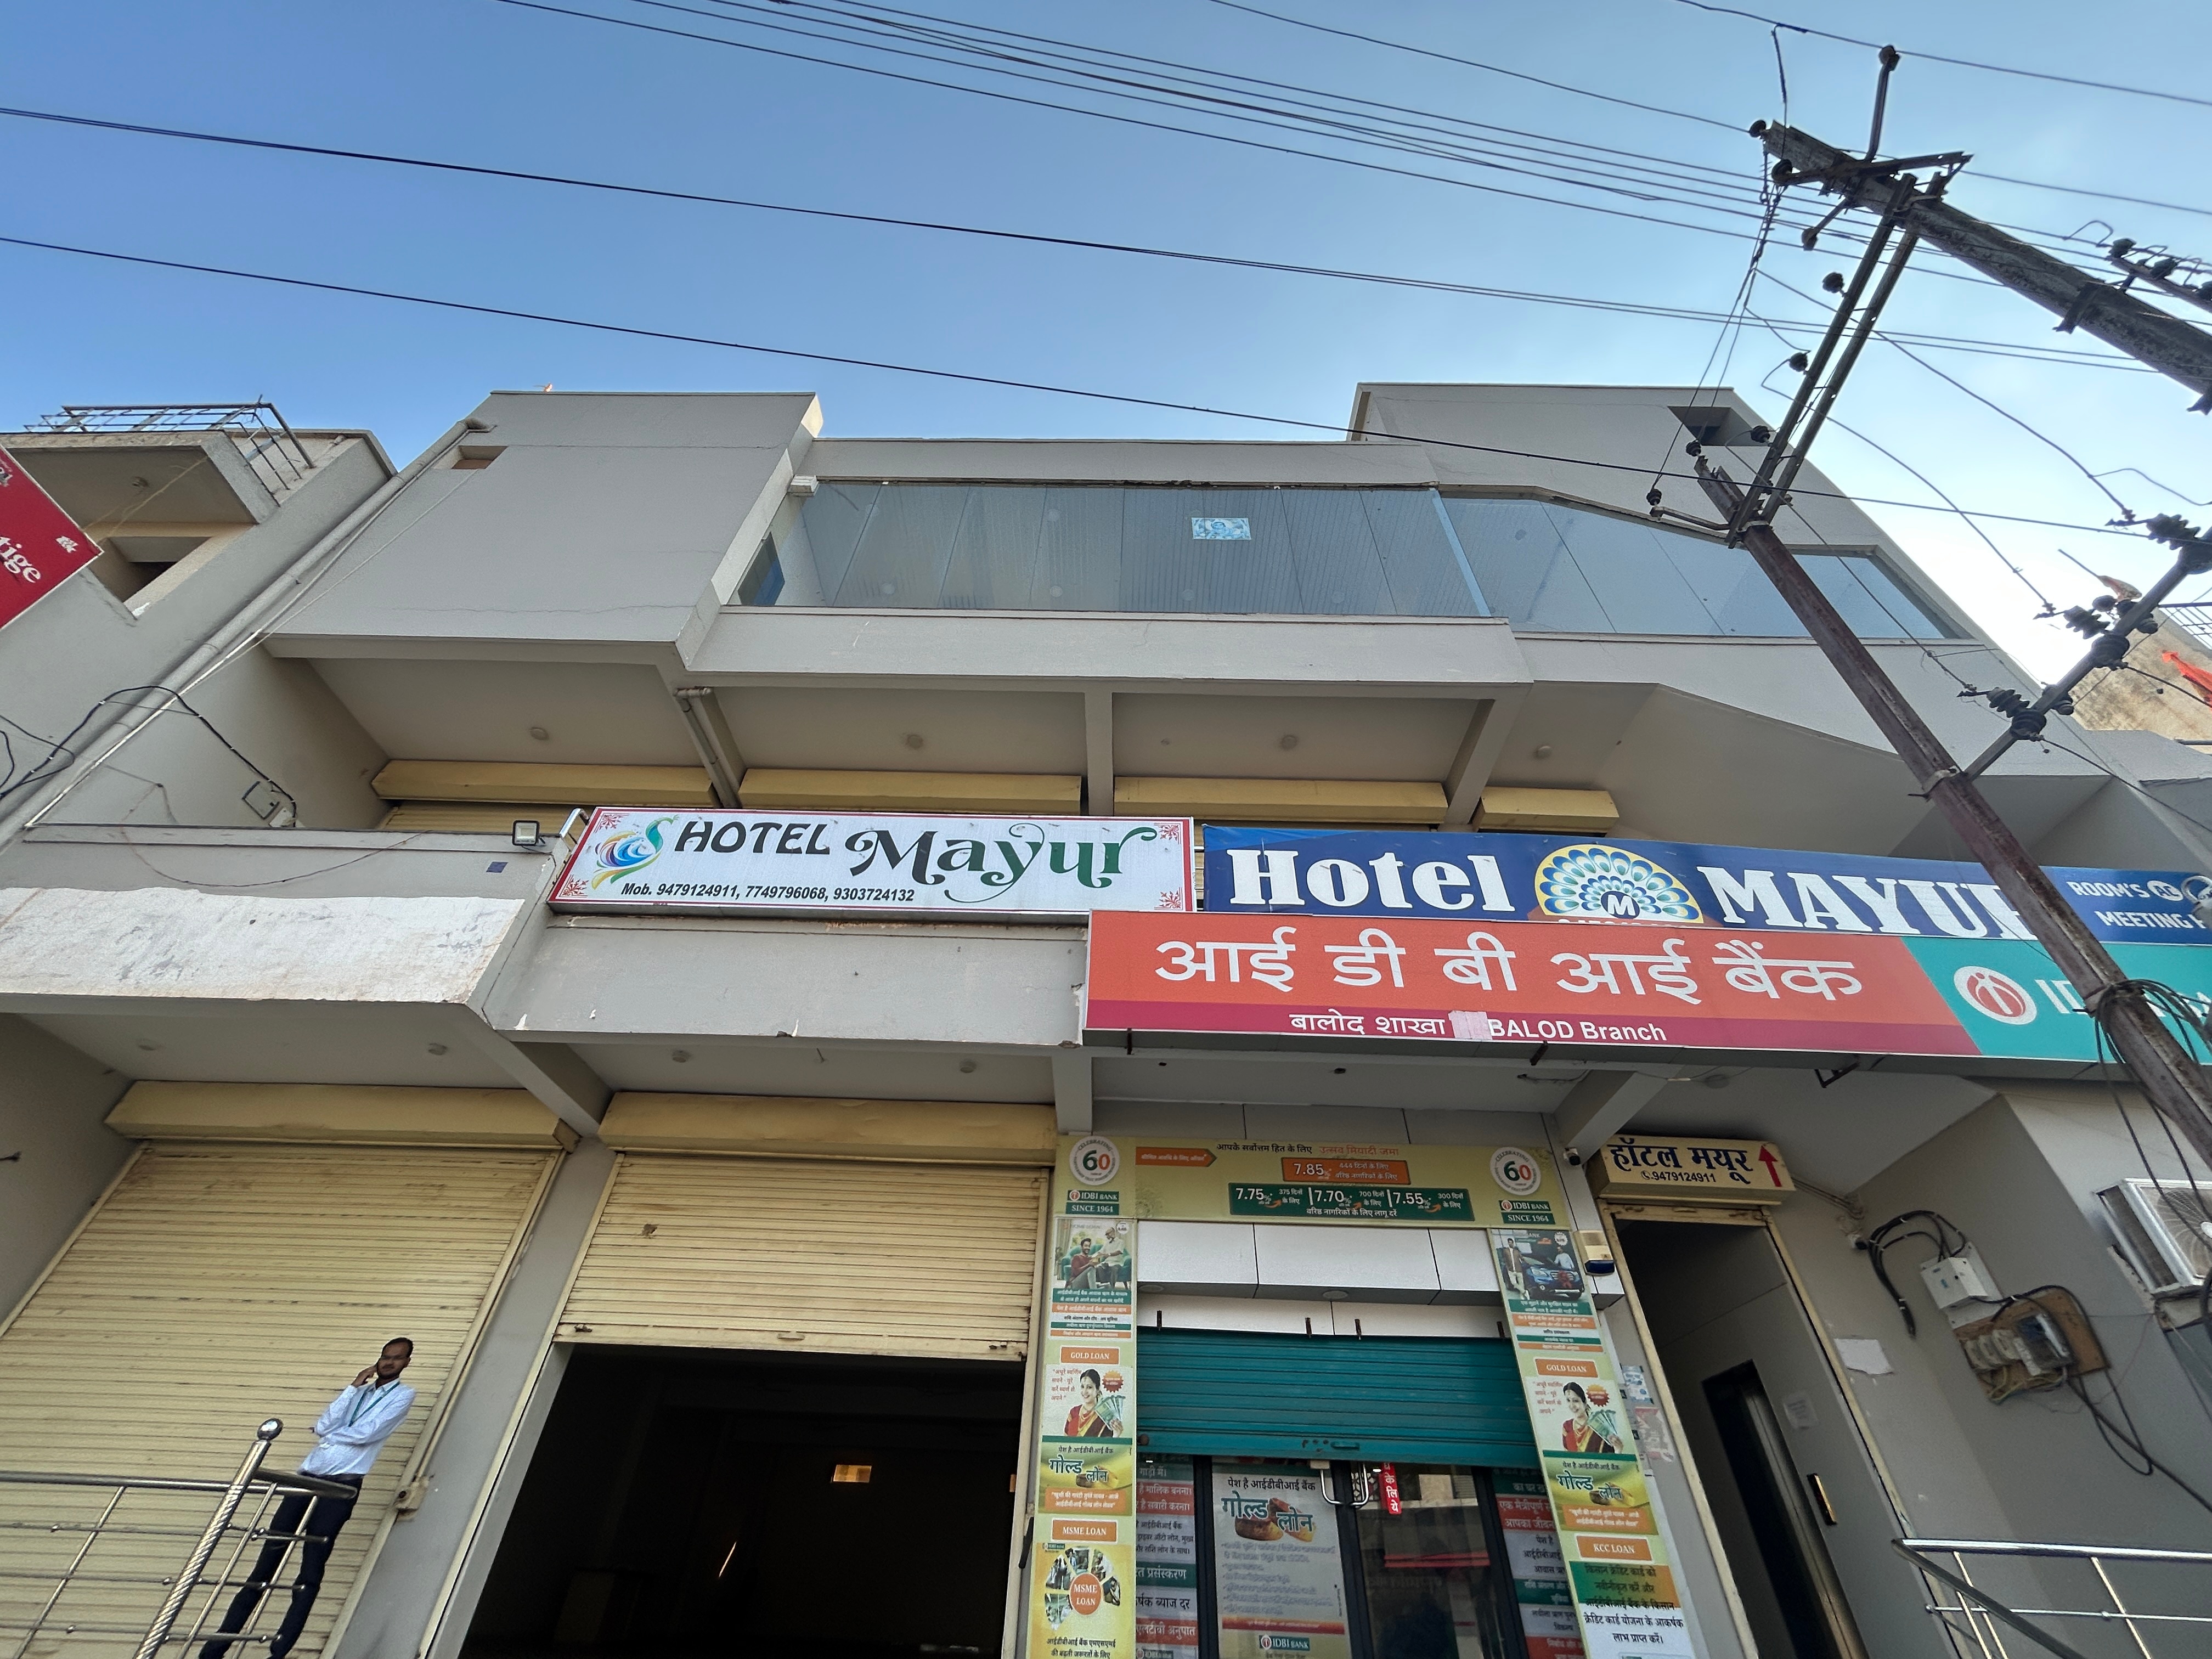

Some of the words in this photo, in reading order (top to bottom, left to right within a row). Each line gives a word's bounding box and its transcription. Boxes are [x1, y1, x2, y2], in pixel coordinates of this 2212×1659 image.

[674, 821, 830, 855] HOTEL
[845, 823, 1157, 903] Mayur
[1227, 849, 1515, 912] Hotel
[621, 883, 652, 896] Mob.
[658, 884, 740, 899] 9479124911,
[746, 885, 828, 902] 7749796068,
[833, 887, 914, 901] 9303724132
[2067, 882, 2150, 898] ROOM'S
[2094, 911, 2193, 928] MEETING
[1155, 926, 1296, 992] आई
[1324, 928, 1406, 988] डी
[1434, 931, 1517, 991] बी
[1551, 938, 1701, 1005] आई
[1712, 939, 1862, 1001] बैंक
[1289, 1008, 1364, 1035] बालोद
[1375, 1016, 1445, 1035] शाखा
[1489, 1019, 1575, 1039] BALOD
[1582, 1023, 1667, 1041] Branch
[1272, 1143, 1285, 1153] हित
[1297, 1144, 1312, 1154] लिए
[1083, 1149, 1110, 1170] 60
[1688, 1147, 1753, 1184] मयूर
[1504, 1160, 1532, 1181] 60
[1359, 1209, 1373, 1217] लिए
[1049, 1454, 1082, 1474] गोल्ड
[1086, 1466, 1108, 1481] लोन
[1557, 1470, 1593, 1490] गोल्ड
[1228, 1477, 1240, 1487] पेश
[1243, 1477, 1249, 1489] है
[1251, 1478, 1299, 1491] आईडीबीआई
[1301, 1480, 1315, 1490] बैंक
[1598, 1483, 1622, 1499] लोन
[1221, 1491, 1268, 1519] गोल्ड
[1277, 1506, 1313, 1532] लोन
[1063, 1526, 1084, 1534] MSME
[1086, 1527, 1107, 1536] LOAN
[1612, 1545, 1635, 1553] LOAN
[1074, 1584, 1097, 1593] MSME
[1076, 1597, 1096, 1605] LOAN
[1155, 1598, 1177, 1608] ब्याज
[1180, 1599, 1190, 1610] दर
[1584, 1612, 1604, 1624] क्रेडिट
[1604, 1613, 1620, 1624] कार्ड
[1621, 1614, 1643, 1626] योजना
[1645, 1615, 1653, 1626] के
[1655, 1616, 1684, 1628] आकर्षक
[1168, 1626, 1196, 1640] अनुपात
[1613, 1633, 1629, 1642] लाभ
[1631, 1634, 1647, 1643] प्राप्त
[1273, 1638, 1289, 1646] IDBI
[1291, 1640, 1308, 1649] BANK
